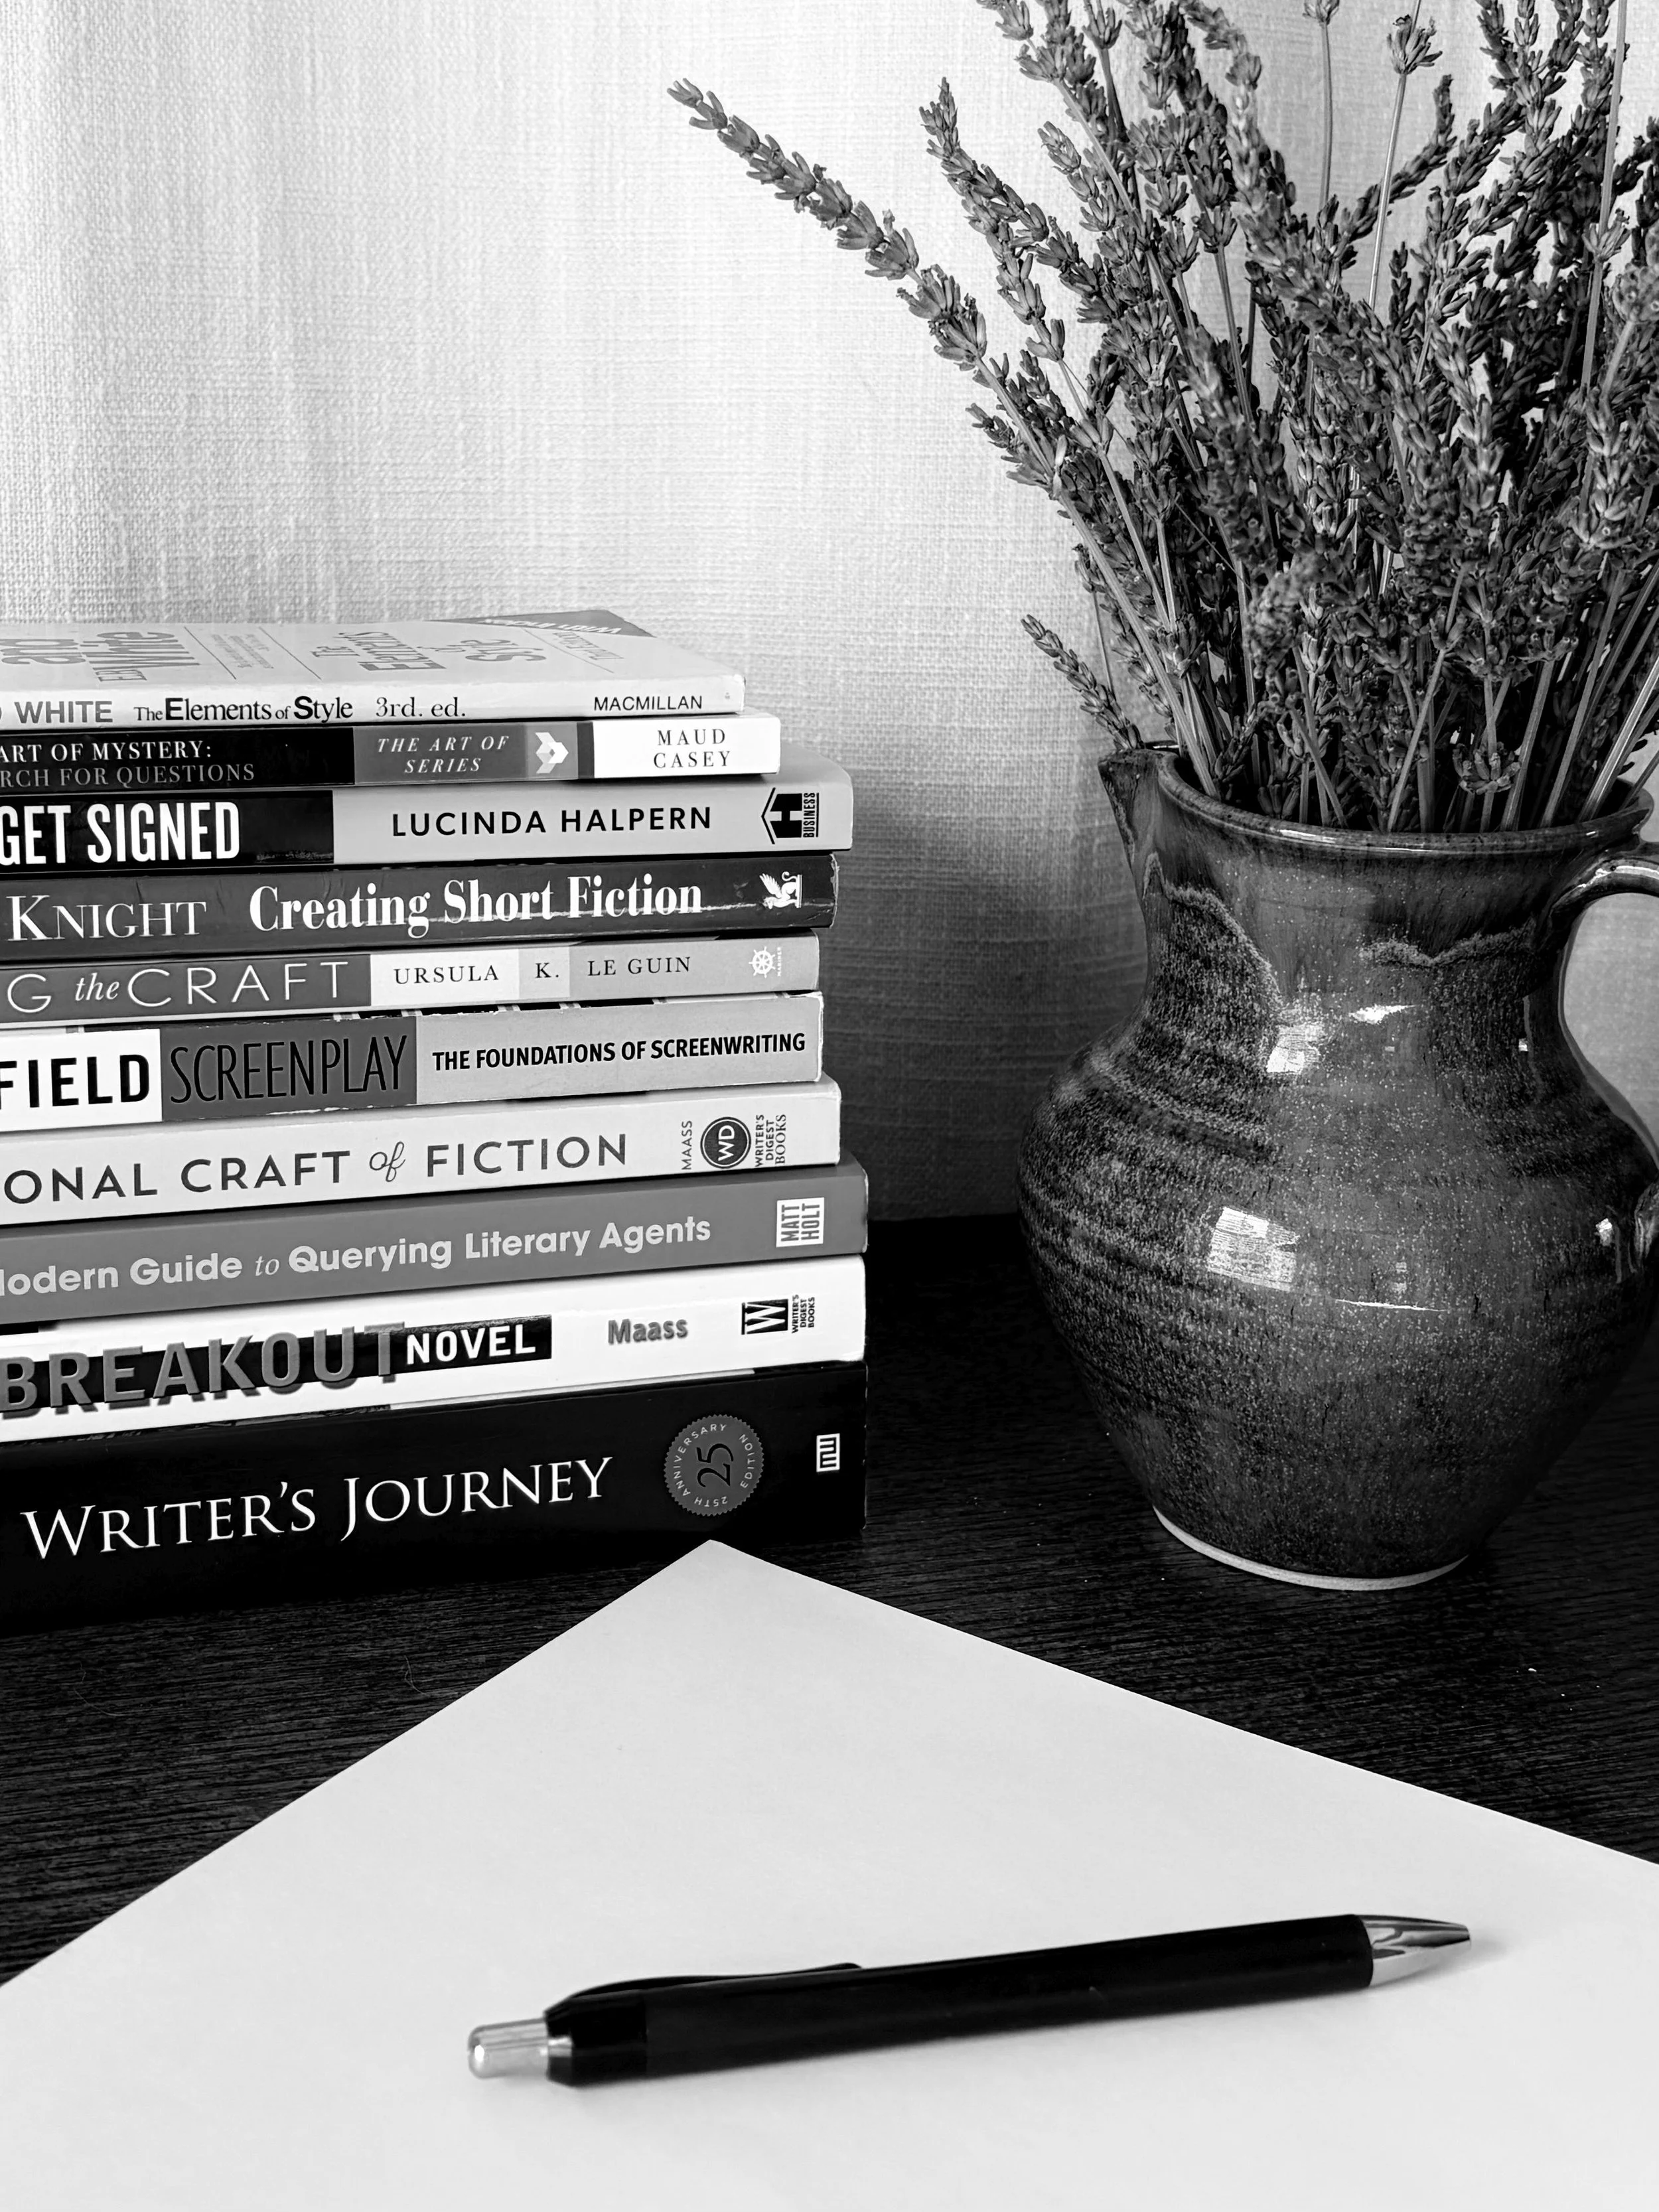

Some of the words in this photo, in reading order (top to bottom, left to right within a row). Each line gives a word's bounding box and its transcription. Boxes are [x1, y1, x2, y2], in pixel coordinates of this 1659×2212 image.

[77, 631, 200, 670] White
[310, 646, 360, 657] The
[333, 631, 447, 671] Elements
[446, 640, 547, 662] Style
[15, 701, 113, 723] WHITE
[134, 707, 163, 721] The
[166, 698, 271, 720] Elements
[275, 706, 291, 719] of
[293, 696, 354, 723] Style
[376, 697, 422, 717] 3rd.
[431, 697, 466, 717] ed.
[594, 696, 703, 711] MACMILLAN
[0, 744, 42, 763] ART
[51, 743, 83, 761] OF
[92, 740, 211, 761] MYSTERY:
[378, 737, 419, 753] THE
[429, 735, 472, 751] ART
[480, 735, 509, 751] OF
[657, 729, 725, 745] MAUD
[60, 768, 108, 786] FOR
[117, 764, 255, 788] QUESTIONS
[404, 758, 482, 774] SERIES
[653, 751, 731, 769] CASEY
[0, 805, 71, 865] GET
[88, 802, 239, 863] SIGNED
[393, 811, 545, 836] LUCINDA
[562, 807, 709, 832] HALPERN
[802, 792, 816, 838] BUSINESS
[250, 883, 430, 938] Creating
[443, 879, 555, 923] Short
[567, 873, 703, 918] Fiction
[76, 973, 119, 1001] the
[128, 961, 349, 1007] CRAFT
[394, 965, 498, 984] URSULA
[535, 962, 559, 980] K.
[589, 960, 616, 976] LE
[628, 957, 690, 974] GUIN
[171, 1035, 407, 1103] SCREENPLAY
[433, 1051, 470, 1070] THE
[477, 1043, 615, 1068] FOUNDATIONS
[622, 1041, 646, 1060] OF
[651, 1033, 805, 1059] SCREENWRITING
[682, 1121, 692, 1169] MAASS
[718, 1125, 735, 1161] WD
[754, 1114, 764, 1167] WRITER'S
[765, 1118, 775, 1161] DIGEST
[775, 1112, 787, 1165] BOOKS
[181, 1151, 350, 1192] CRAFT
[370, 1142, 405, 1182] of
[427, 1133, 627, 1175] FICTION
[780, 1204, 800, 1242] MATT
[800, 1203, 820, 1240] HOLT
[0, 1266, 118, 1296] odern
[130, 1253, 242, 1285] Guide
[254, 1255, 280, 1276] to
[289, 1238, 451, 1272] Querying
[465, 1230, 592, 1260] Literary
[599, 1215, 711, 1253] Agents
[607, 1317, 689, 1346] Maass
[0, 1321, 405, 1412] BREAKOUT
[406, 1323, 537, 1365] NOVEL
[673, 1423, 727, 1497] ANNIVERSARY
[696, 1443, 734, 1488] 25
[739, 1434, 755, 1489] EDITION
[21, 1482, 315, 1558] WRITER'S
[341, 1457, 613, 1541] JOURNEY
[693, 1495, 729, 1508] 25TH
